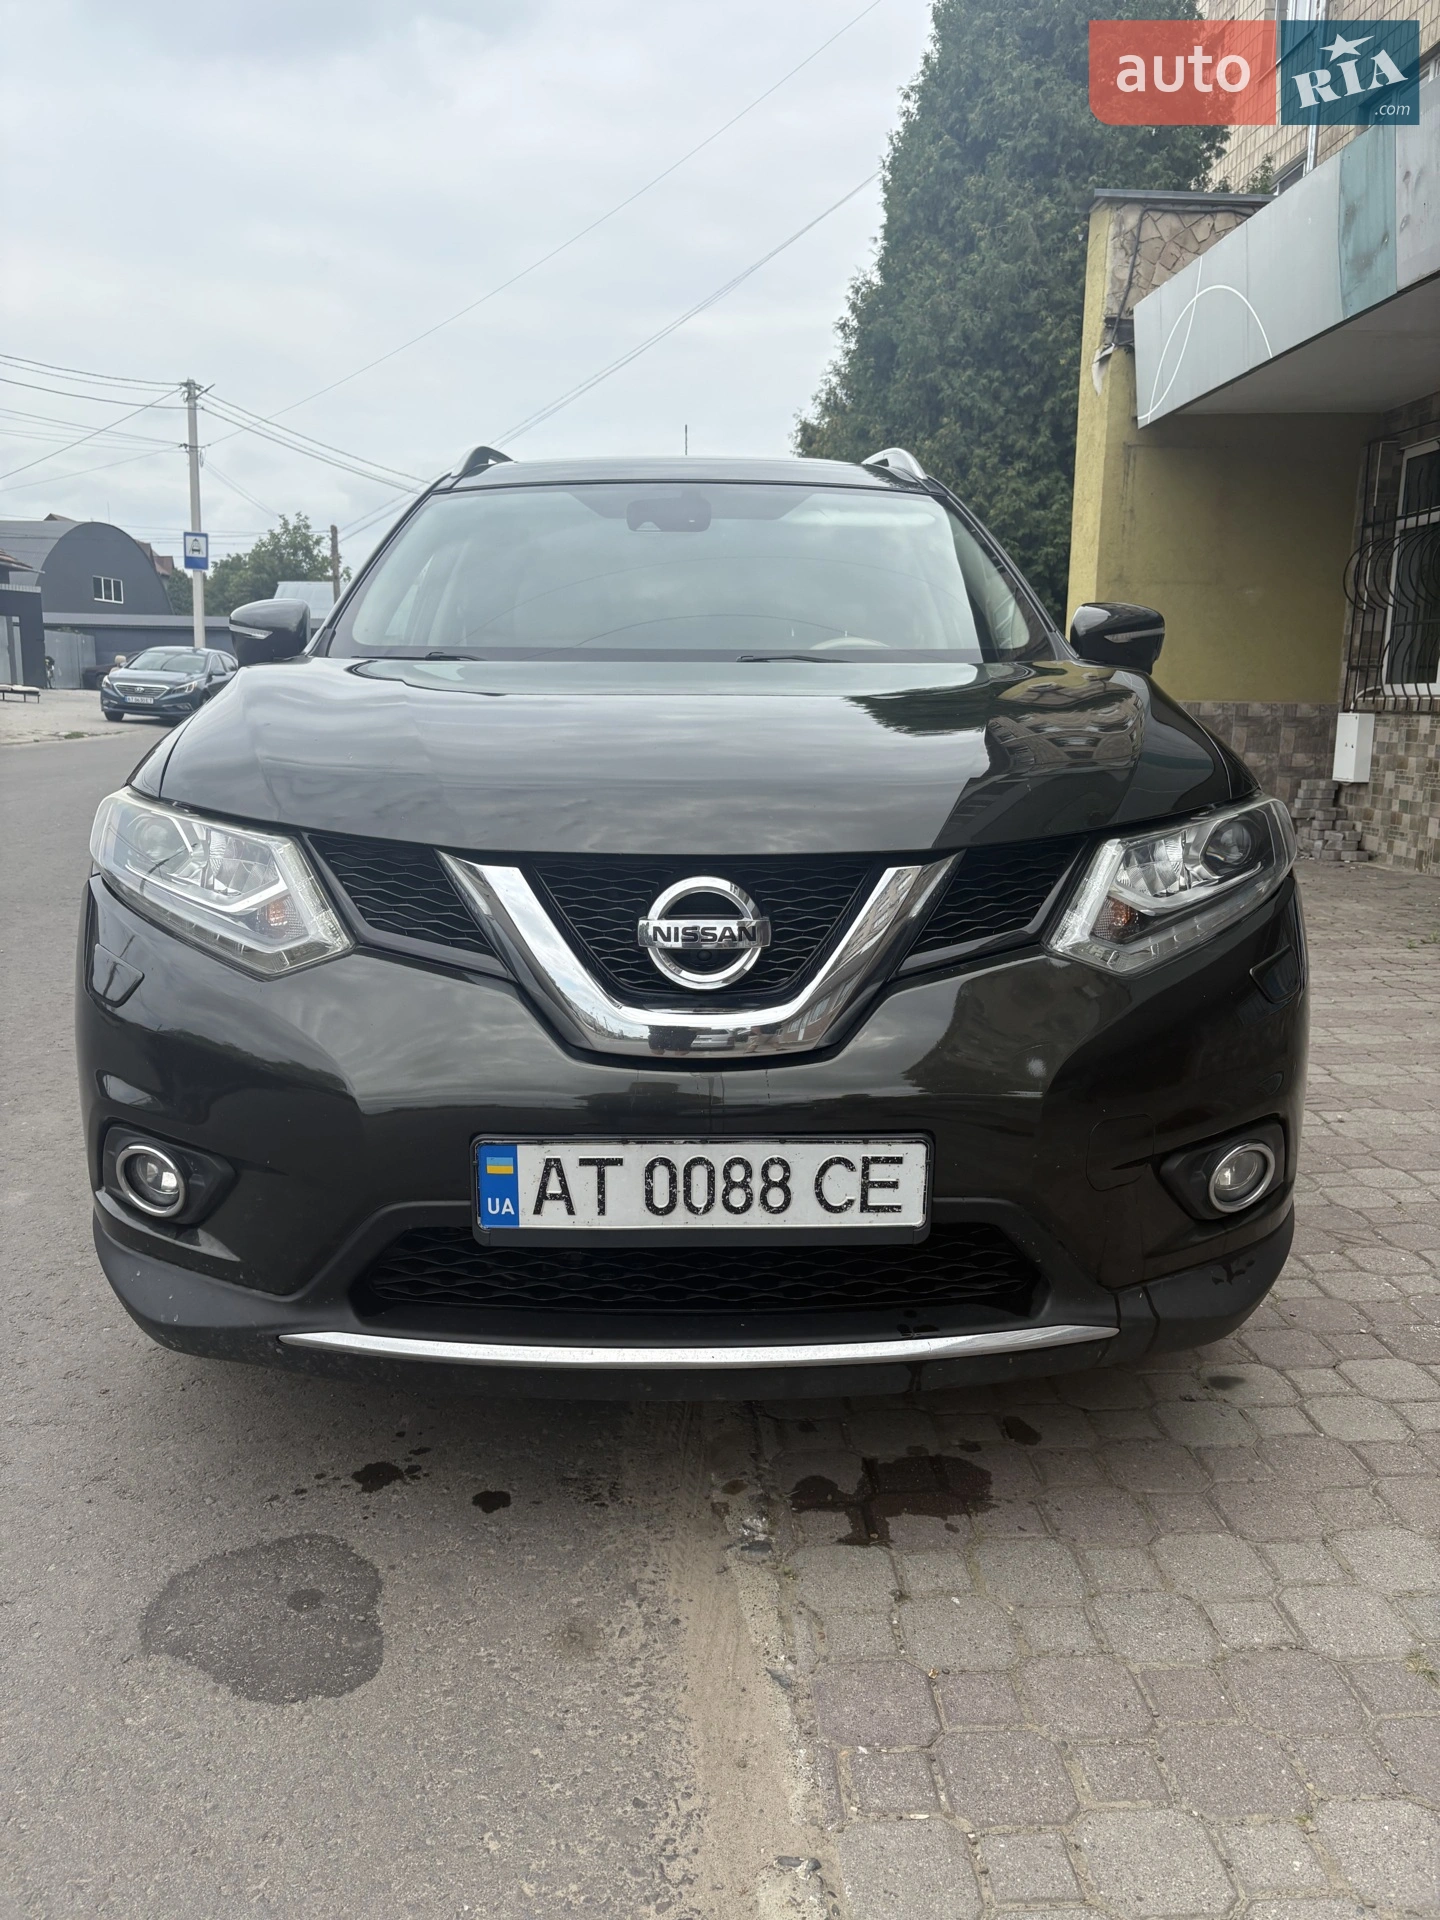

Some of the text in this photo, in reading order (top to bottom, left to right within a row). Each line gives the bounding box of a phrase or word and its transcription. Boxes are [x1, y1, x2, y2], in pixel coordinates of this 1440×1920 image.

[652, 926, 757, 943] NISSAN
[532, 1155, 904, 1216] AT 0088 CE
[487, 1197, 515, 1215] UA
